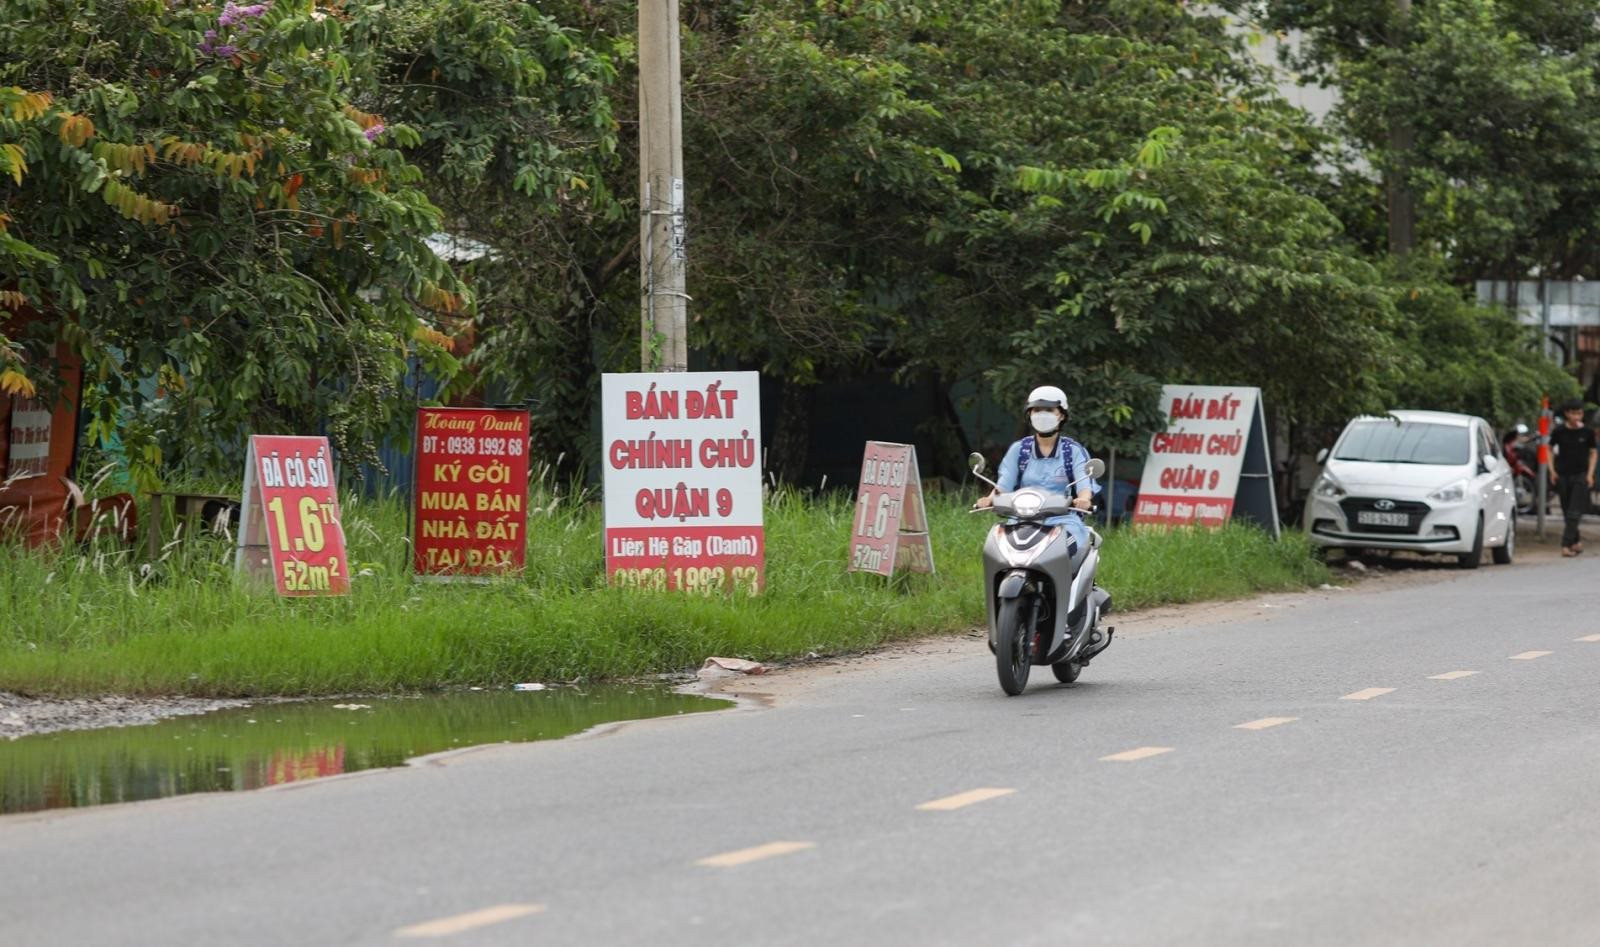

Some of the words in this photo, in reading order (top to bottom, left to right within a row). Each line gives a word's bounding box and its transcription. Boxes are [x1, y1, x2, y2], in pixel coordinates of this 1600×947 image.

[625, 381, 680, 420] BÁN
[685, 379, 738, 420] ĐẤT
[1170, 392, 1204, 419] BÁN
[480, 414, 523, 431] Danh
[447, 436, 475, 454] 0938
[478, 437, 506, 456] 1992
[508, 438, 523, 456] 68
[608, 430, 692, 470] CHÍNH
[699, 429, 755, 469] CHỦ
[1152, 427, 1204, 455] CHÍNH
[1206, 429, 1242, 456] CHỦ
[261, 451, 284, 487] ĐÃ
[285, 451, 306, 487] CÓ
[307, 446, 329, 487] SỔ
[434, 459, 462, 482] KÝ
[468, 459, 510, 484] GỞI
[1160, 464, 1206, 493] QUẬN
[1208, 470, 1220, 490] 9
[421, 491, 469, 511] MUA
[476, 489, 521, 513] BÁN
[635, 481, 710, 523] QUẬN
[716, 487, 733, 518] 9
[423, 515, 469, 539] NHÀ
[476, 514, 519, 540] ĐẤT
[612, 537, 645, 557] Liên
[648, 536, 669, 558] Hệ
[706, 535, 758, 556] (Danh)
